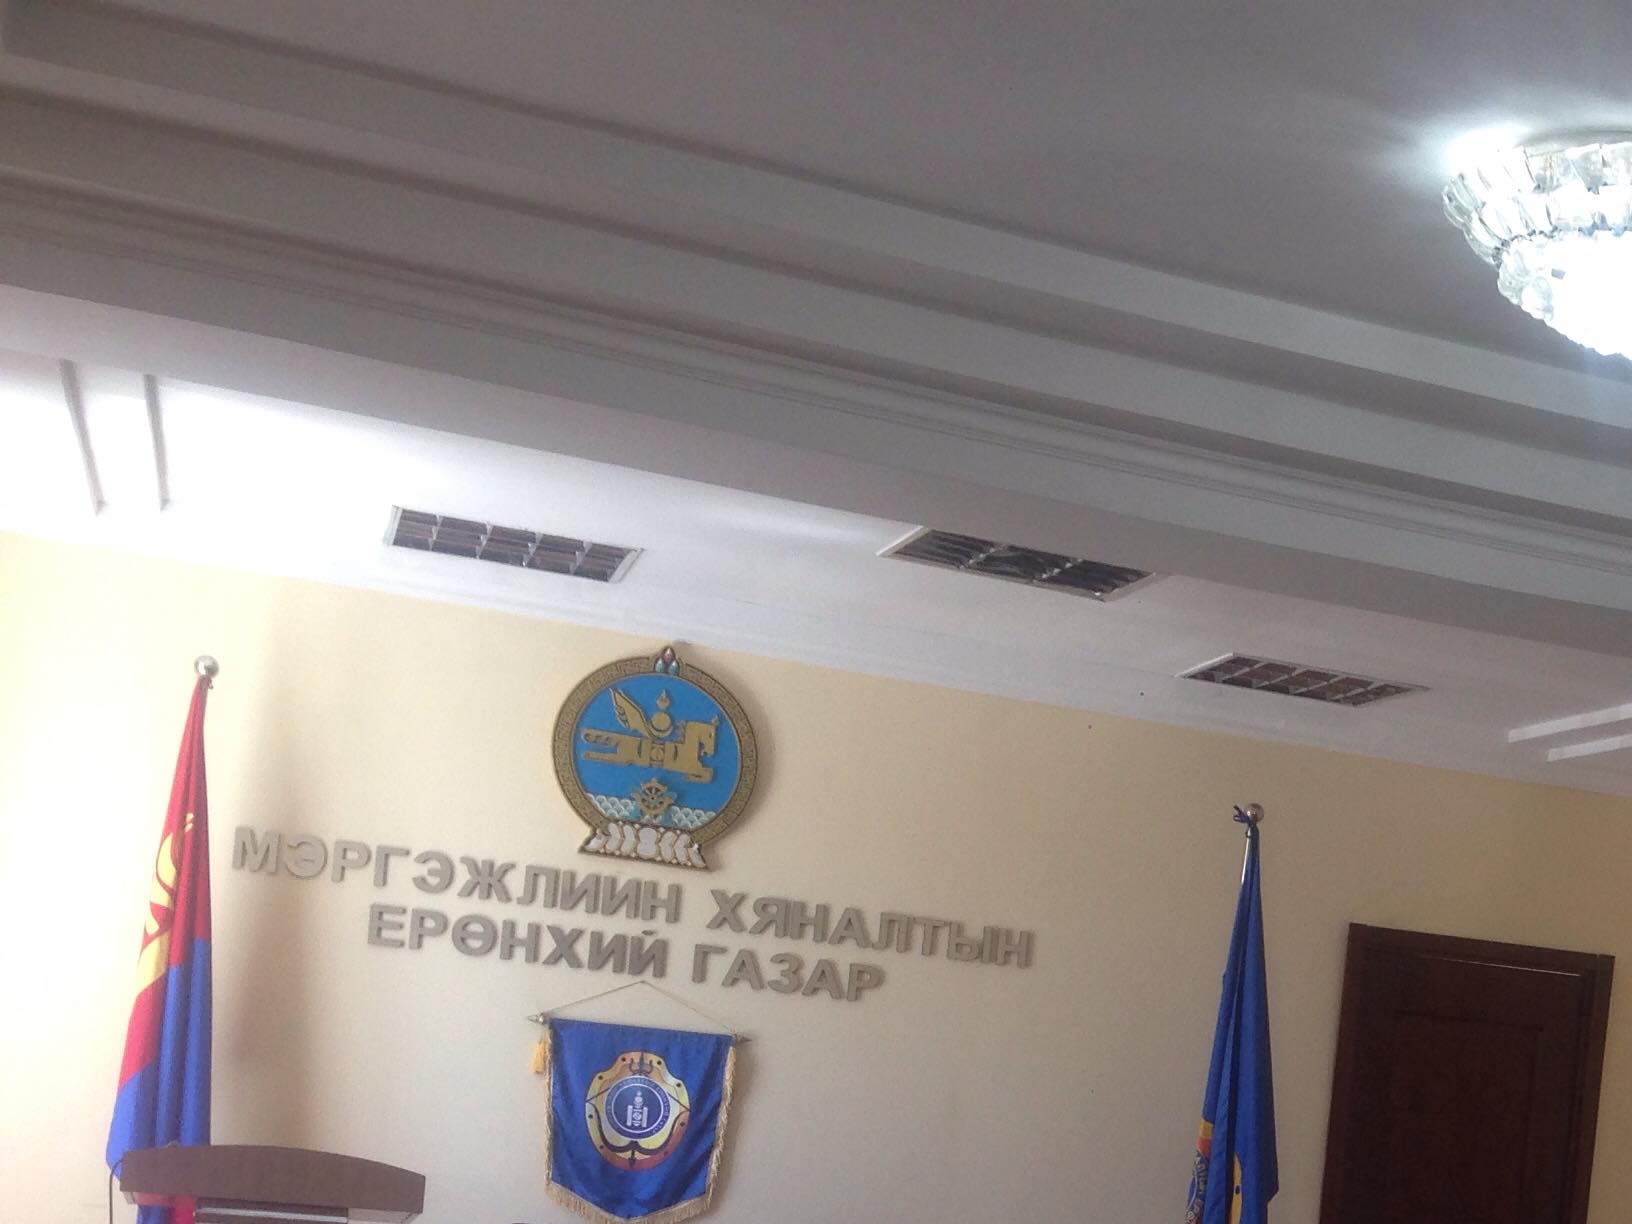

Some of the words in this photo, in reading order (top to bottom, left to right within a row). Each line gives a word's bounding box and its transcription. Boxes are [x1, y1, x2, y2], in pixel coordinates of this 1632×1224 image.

[232, 825, 683, 924] МЭРГЭЖЛИИН
[706, 889, 1036, 969] ХЯНАЛТЫН
[368, 903, 669, 978] ЕРӨНХИЙ
[691, 943, 886, 1001] ГАЗАР
